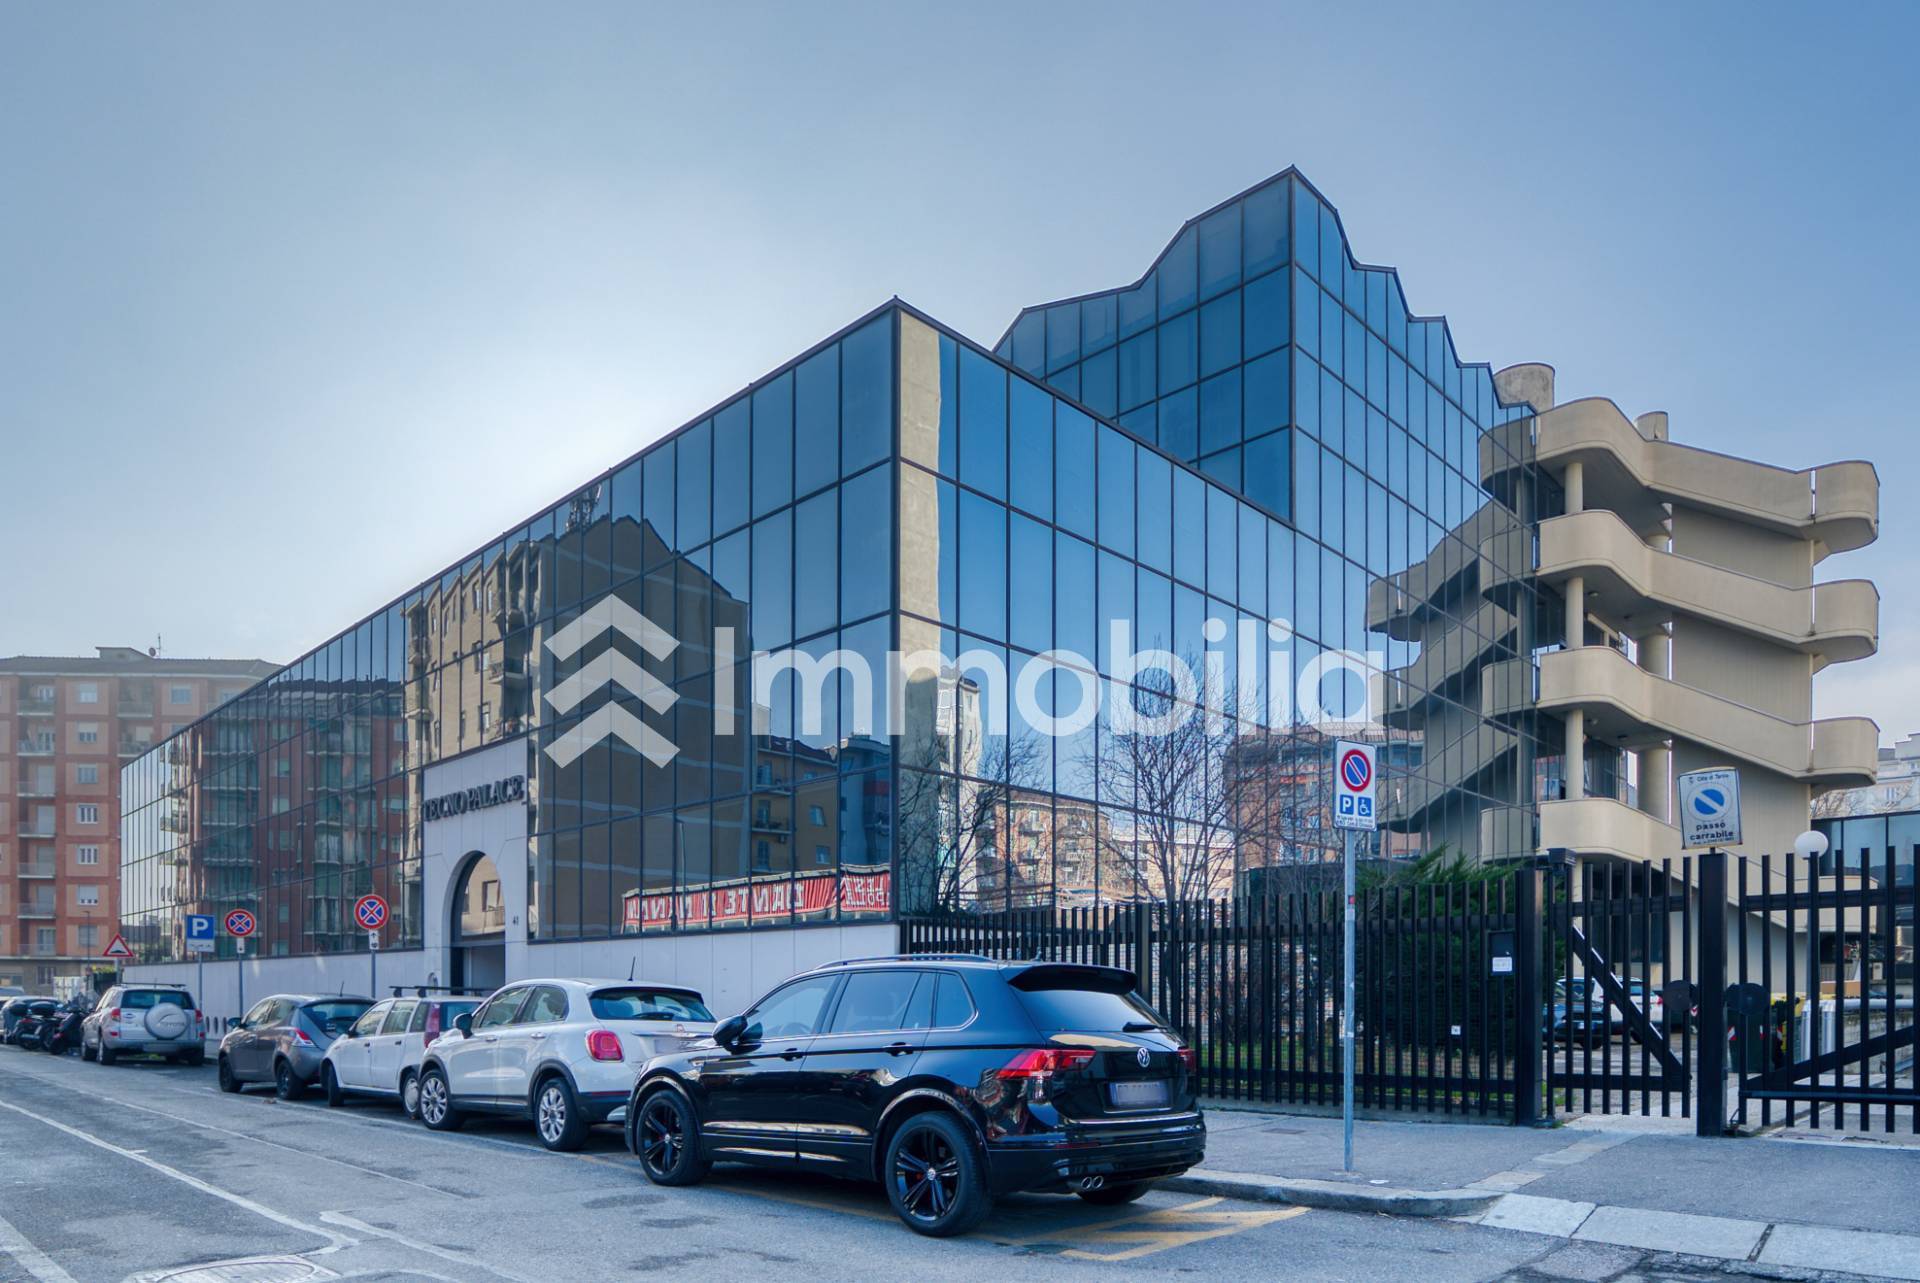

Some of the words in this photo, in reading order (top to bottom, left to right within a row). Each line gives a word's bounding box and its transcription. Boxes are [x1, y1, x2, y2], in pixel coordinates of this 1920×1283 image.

[1342, 797, 1351, 812] P
[1696, 822, 1726, 831] passo
[1690, 830, 1734, 841] carrabile
[192, 918, 208, 936] P
